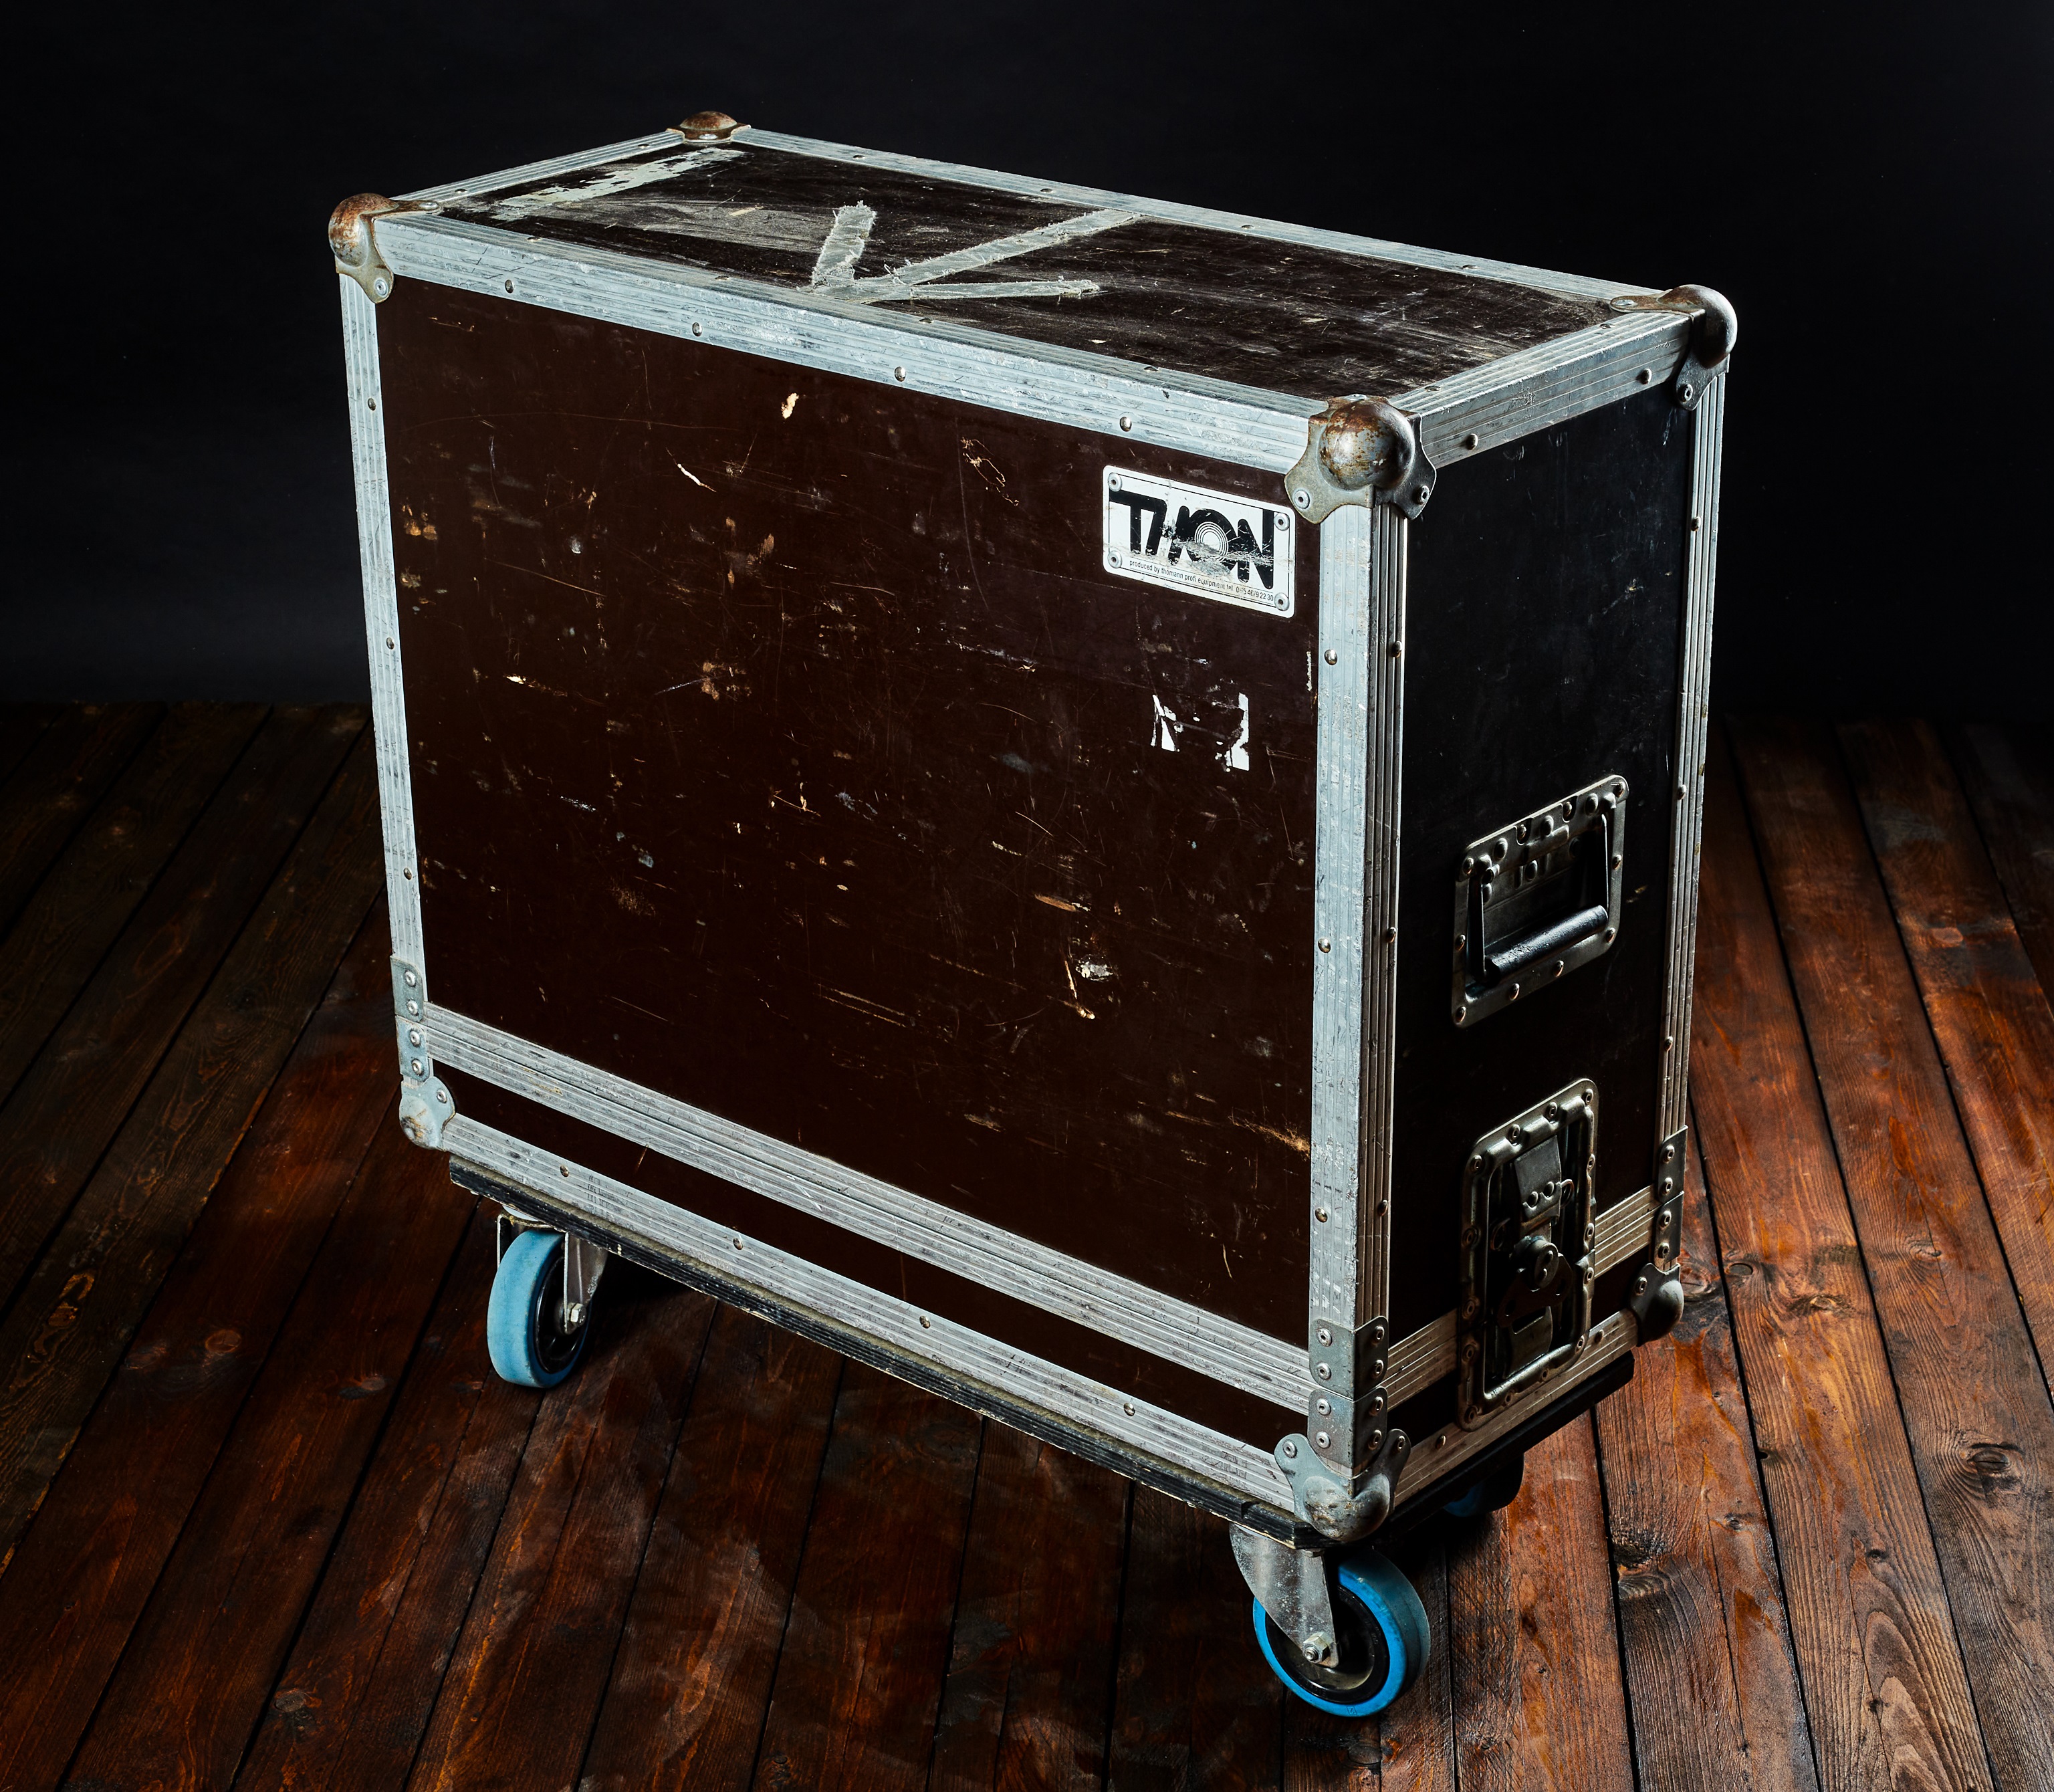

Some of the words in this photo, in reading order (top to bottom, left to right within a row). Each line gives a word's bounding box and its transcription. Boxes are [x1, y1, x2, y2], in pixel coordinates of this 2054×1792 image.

[1130, 560, 1153, 571] produced
[1154, 566, 1160, 574] by
[1161, 568, 1183, 578] thomann
